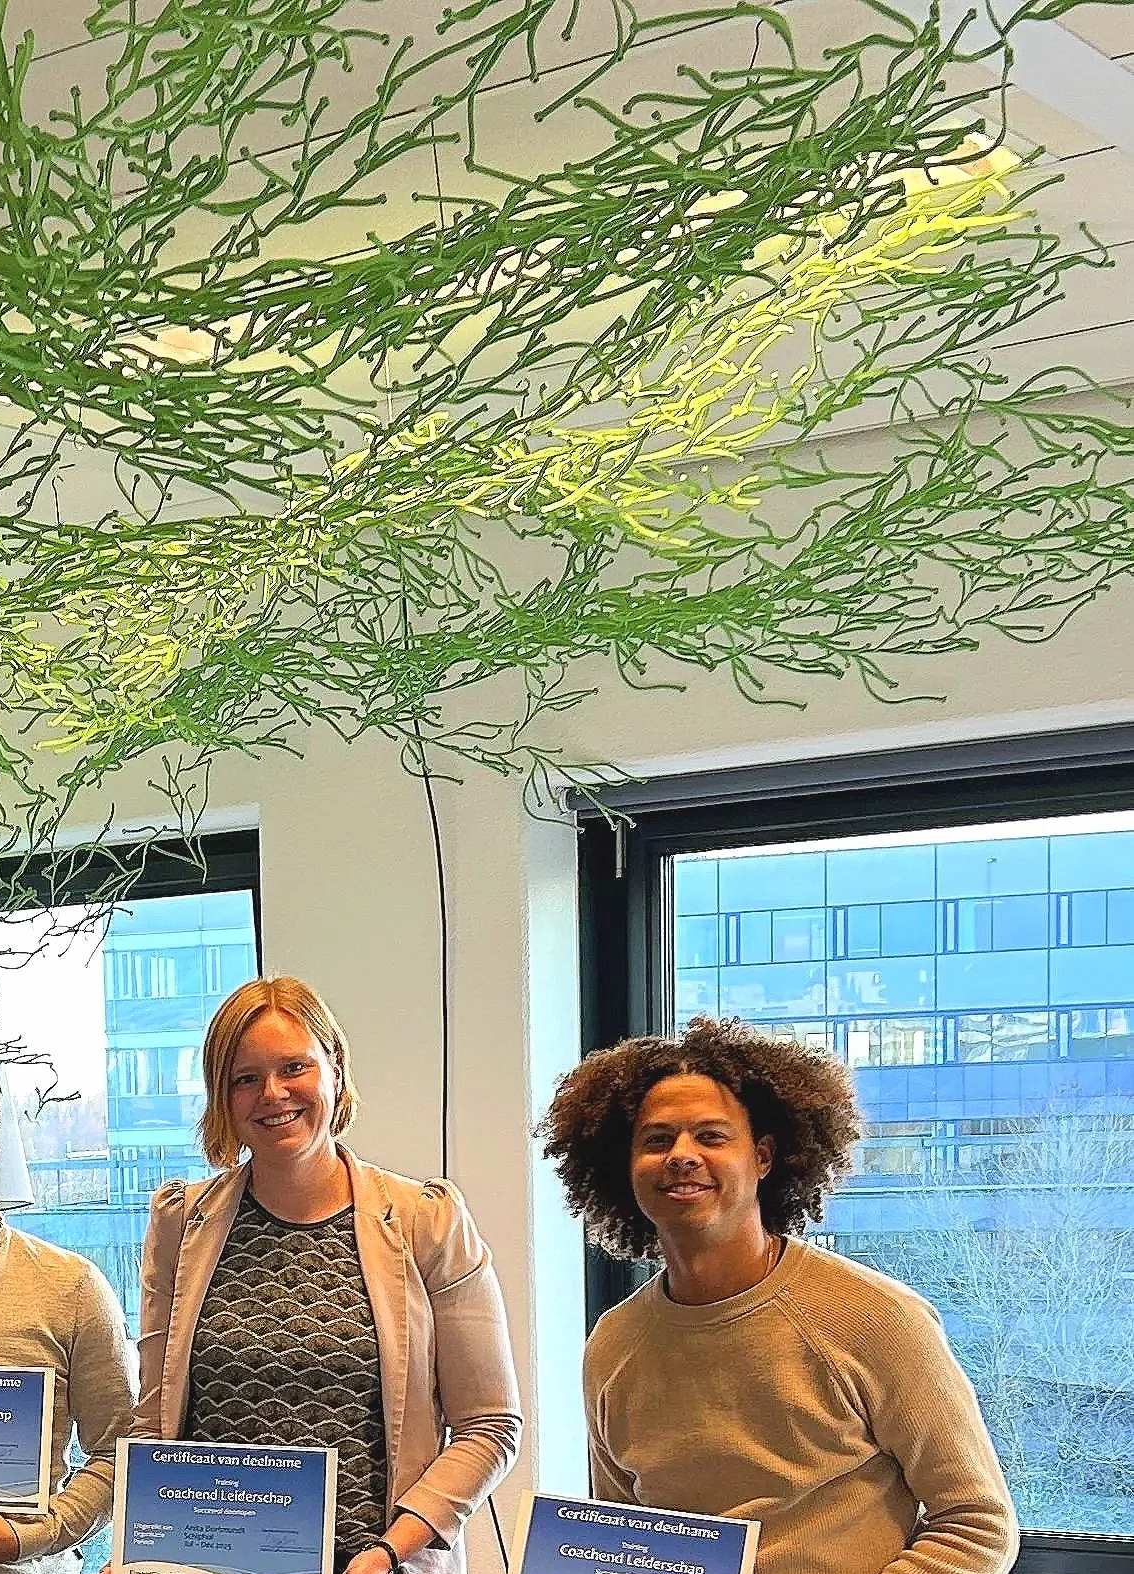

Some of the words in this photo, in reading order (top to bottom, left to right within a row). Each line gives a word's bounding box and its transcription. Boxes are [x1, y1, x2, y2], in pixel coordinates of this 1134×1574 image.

[152, 1450, 215, 1465] Certificaat
[217, 1456, 239, 1466] van
[242, 1454, 302, 1469] deelname
[159, 1487, 217, 1501] Coachend
[221, 1489, 292, 1506] Leiderschap
[557, 1507, 625, 1527] Certificaat
[628, 1519, 652, 1531] van
[654, 1520, 720, 1540] deelname
[559, 1544, 624, 1564] Coachend
